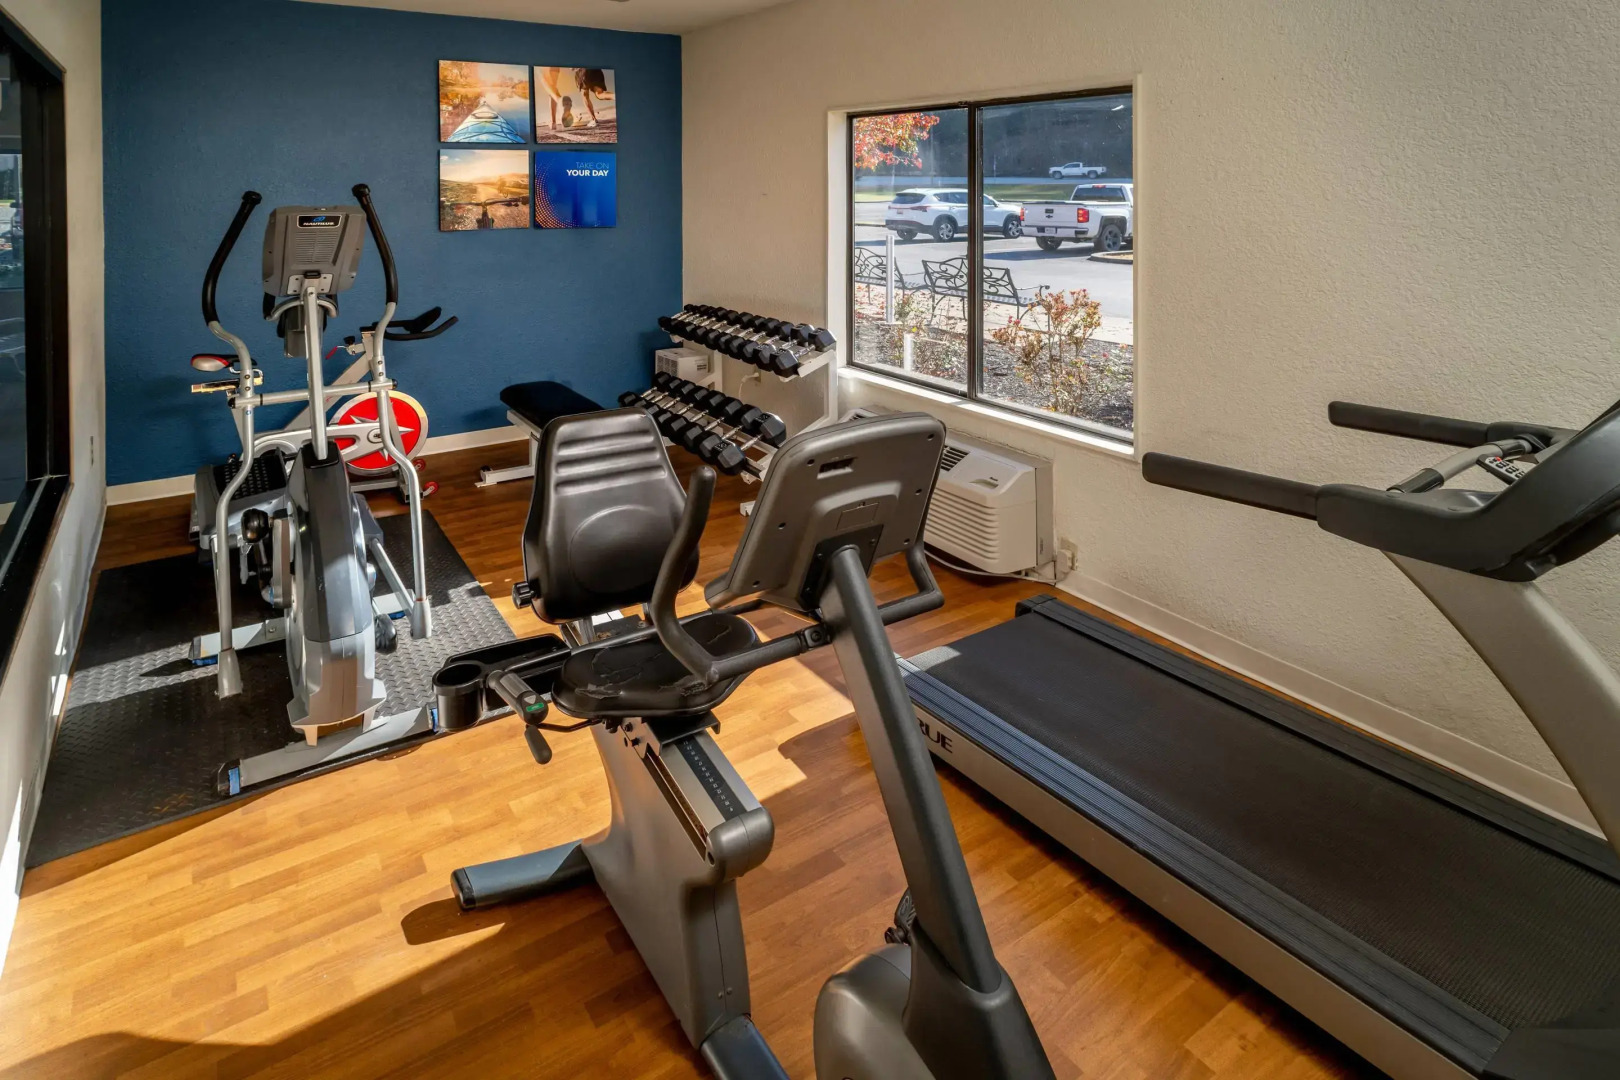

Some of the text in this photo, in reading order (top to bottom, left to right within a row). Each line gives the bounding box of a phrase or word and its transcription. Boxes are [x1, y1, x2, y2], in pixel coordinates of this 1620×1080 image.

[566, 169, 609, 177] YOUR DAY
[917, 717, 953, 754] RUE
